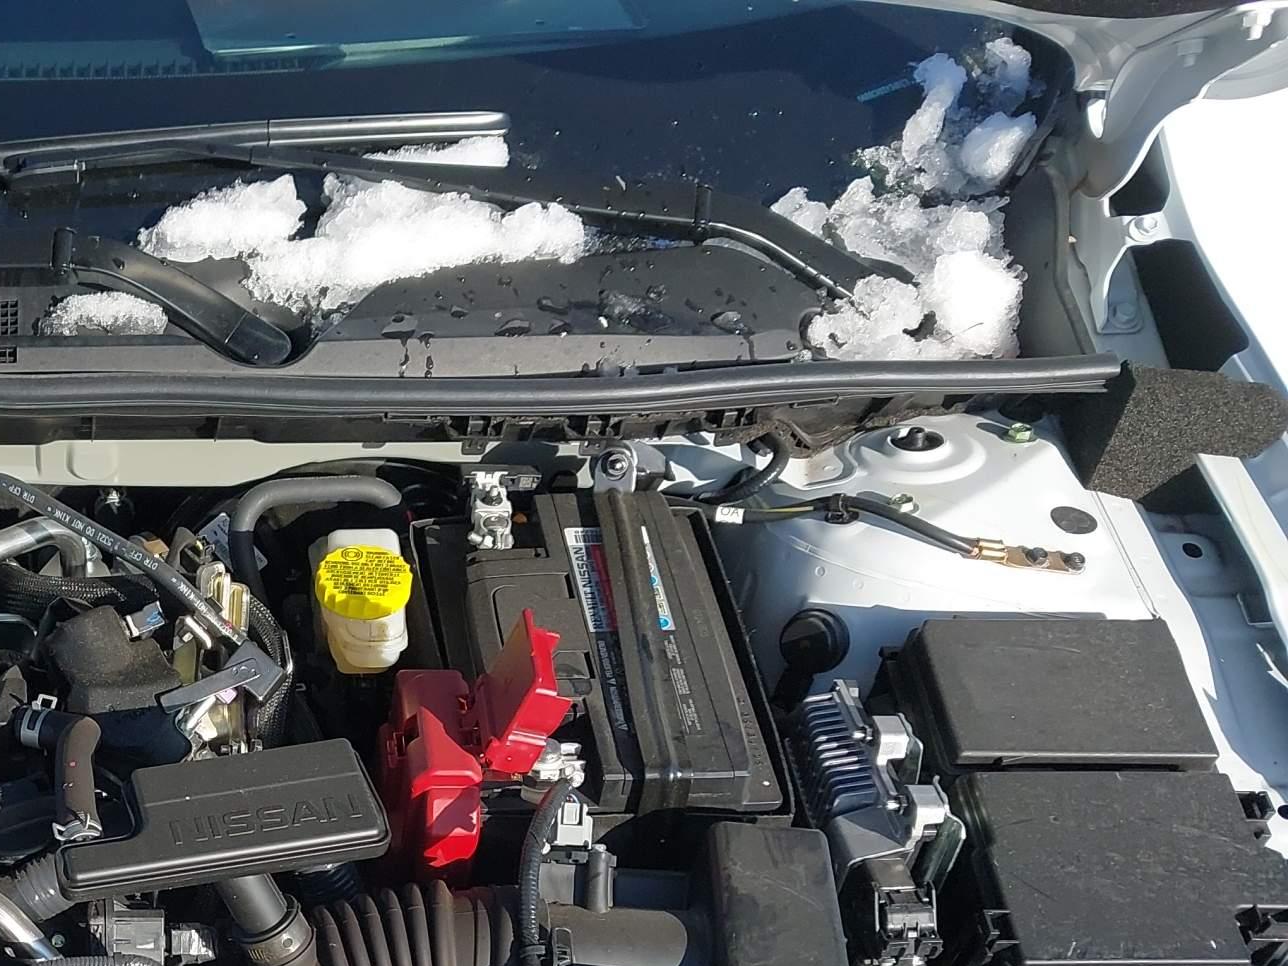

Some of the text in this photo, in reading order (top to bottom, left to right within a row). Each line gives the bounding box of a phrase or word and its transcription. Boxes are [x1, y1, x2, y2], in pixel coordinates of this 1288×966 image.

[22, 491, 35, 502] DTR
[52, 507, 71, 523] KINK
[70, 517, 85, 531] NOT
[84, 525, 95, 536] DO
[95, 530, 114, 547] 5321
[143, 556, 159, 571] DTR
[573, 545, 592, 589] NISSAN
[169, 793, 363, 844] NISSAN
